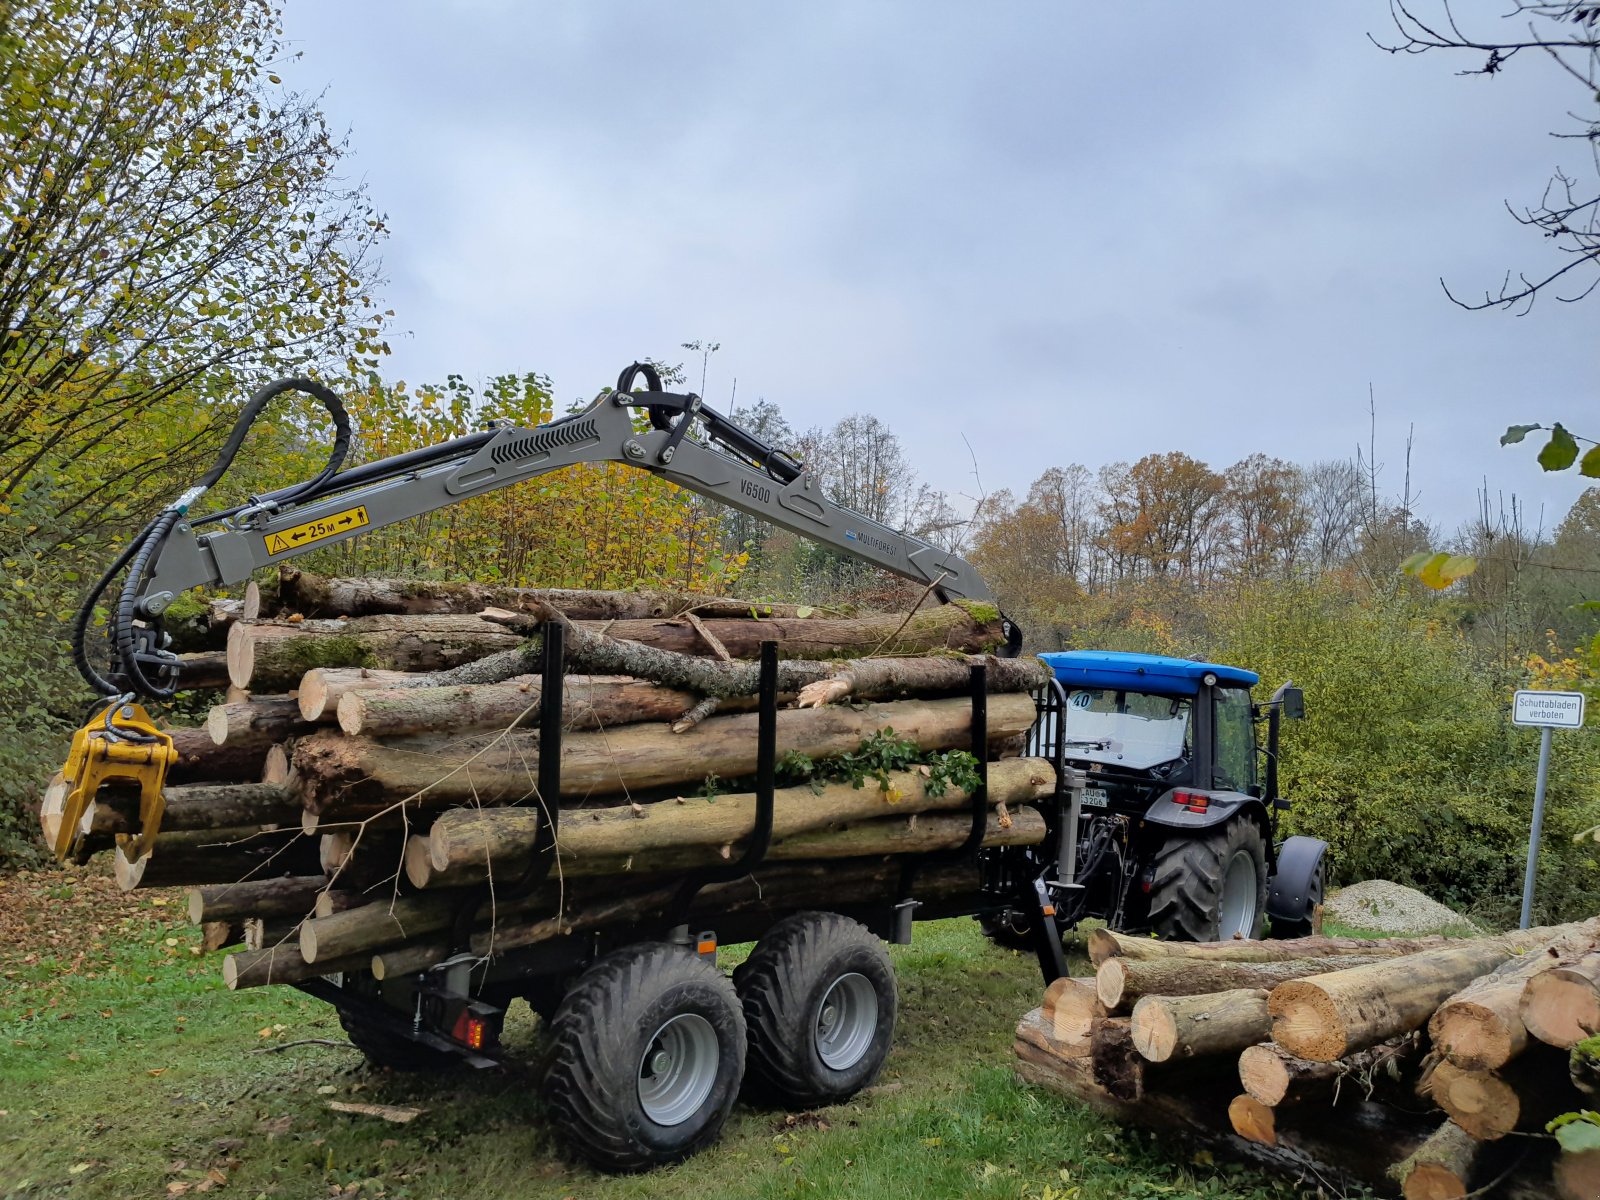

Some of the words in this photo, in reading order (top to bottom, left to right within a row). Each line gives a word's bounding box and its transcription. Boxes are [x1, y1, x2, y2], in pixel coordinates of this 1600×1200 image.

[741, 478, 770, 504] V6500
[857, 531, 897, 556] MULTIFOREST
[1073, 694, 1090, 708] 40
[1519, 697, 1577, 710] Schuttabladen
[1529, 709, 1564, 719] verboten
